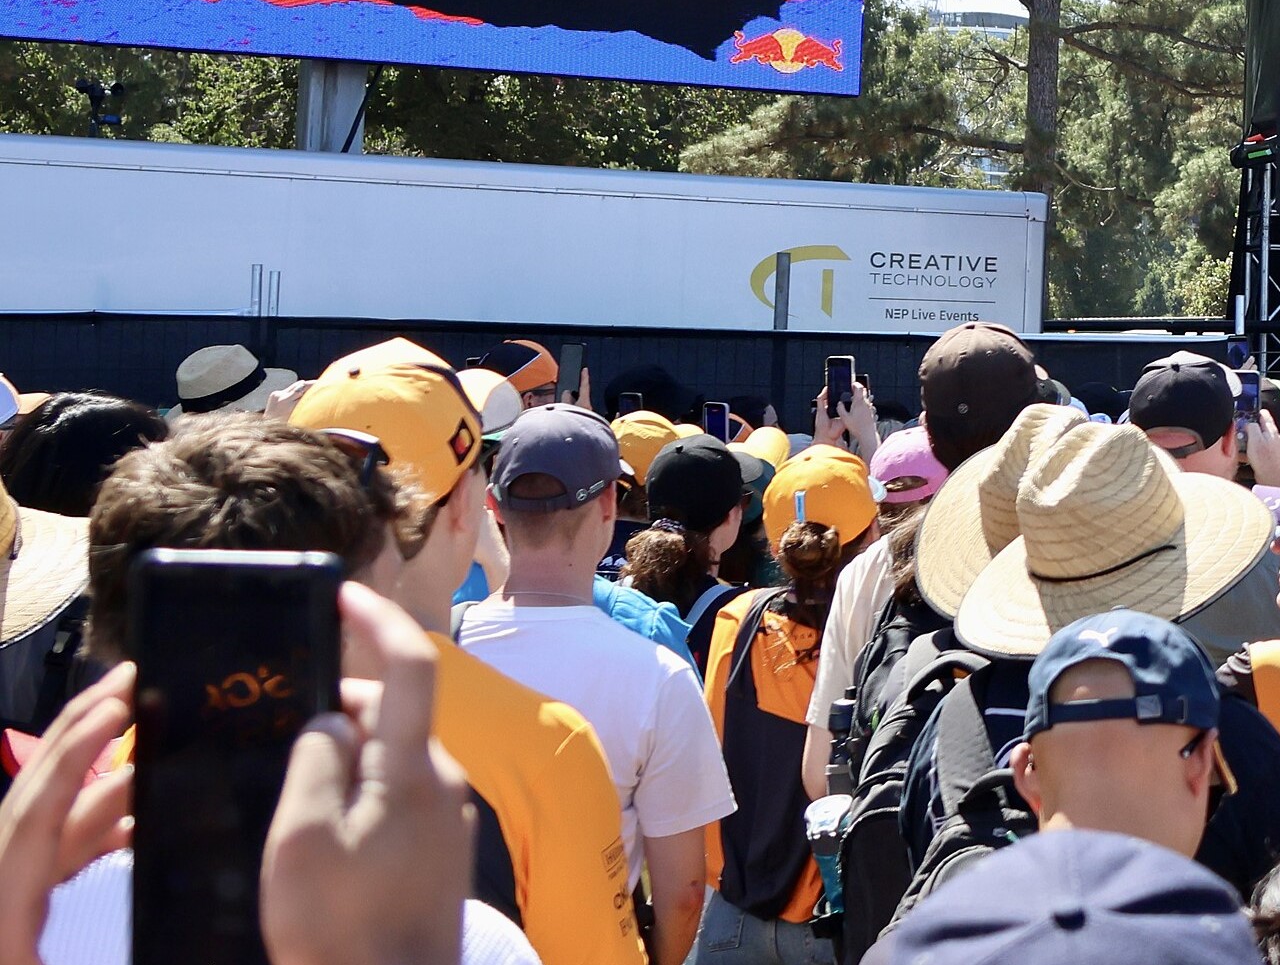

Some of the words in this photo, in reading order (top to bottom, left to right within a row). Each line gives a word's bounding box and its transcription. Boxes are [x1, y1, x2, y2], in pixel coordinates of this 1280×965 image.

[869, 251, 998, 273] CREATIVE
[869, 272, 997, 289] TECHNOLOGY
[885, 308, 910, 320] NEP
[911, 309, 936, 321] Live
[939, 309, 980, 322] Events
